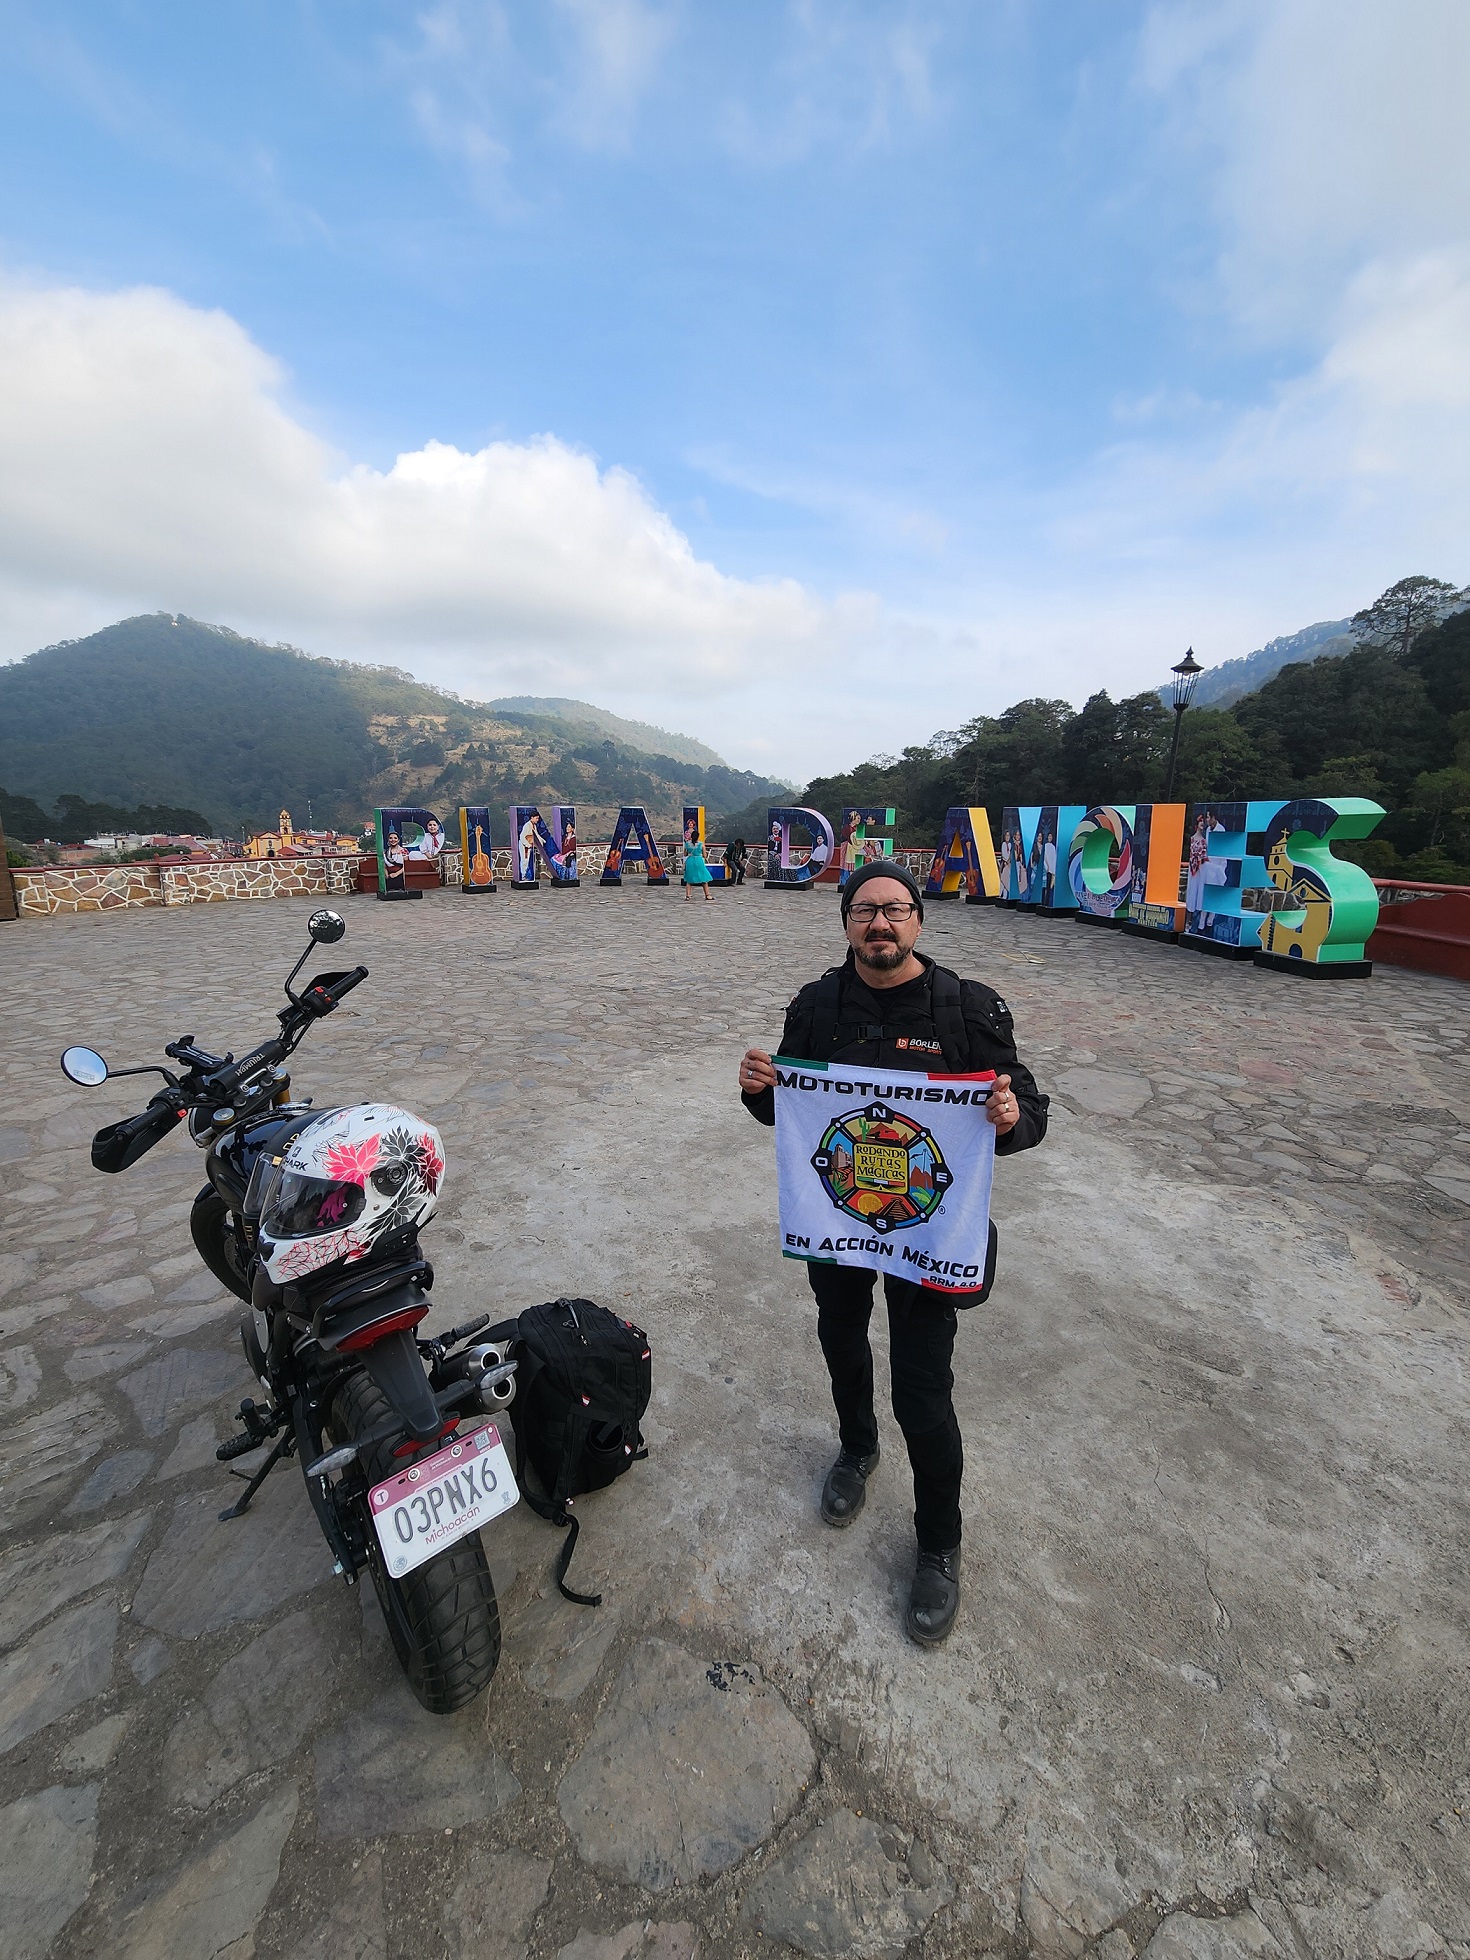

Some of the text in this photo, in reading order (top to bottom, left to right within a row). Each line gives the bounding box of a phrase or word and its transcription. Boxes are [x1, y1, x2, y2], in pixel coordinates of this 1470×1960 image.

[925, 797, 1388, 964] AMOLES
[234, 1053, 266, 1077] TRIUMPH
[776, 1070, 994, 1106] MOTOTURISMO
[872, 1107, 887, 1119] N
[815, 1156, 829, 1167] O
[936, 1172, 948, 1183] E
[875, 1218, 888, 1229] S
[785, 1233, 979, 1278] EN ACCIÓN MÉXICO
[929, 1275, 956, 1288] RRM
[378, 1491, 386, 1503] T
[394, 1457, 498, 1544] 03PNX6
[424, 1506, 481, 1545] Michoacán
